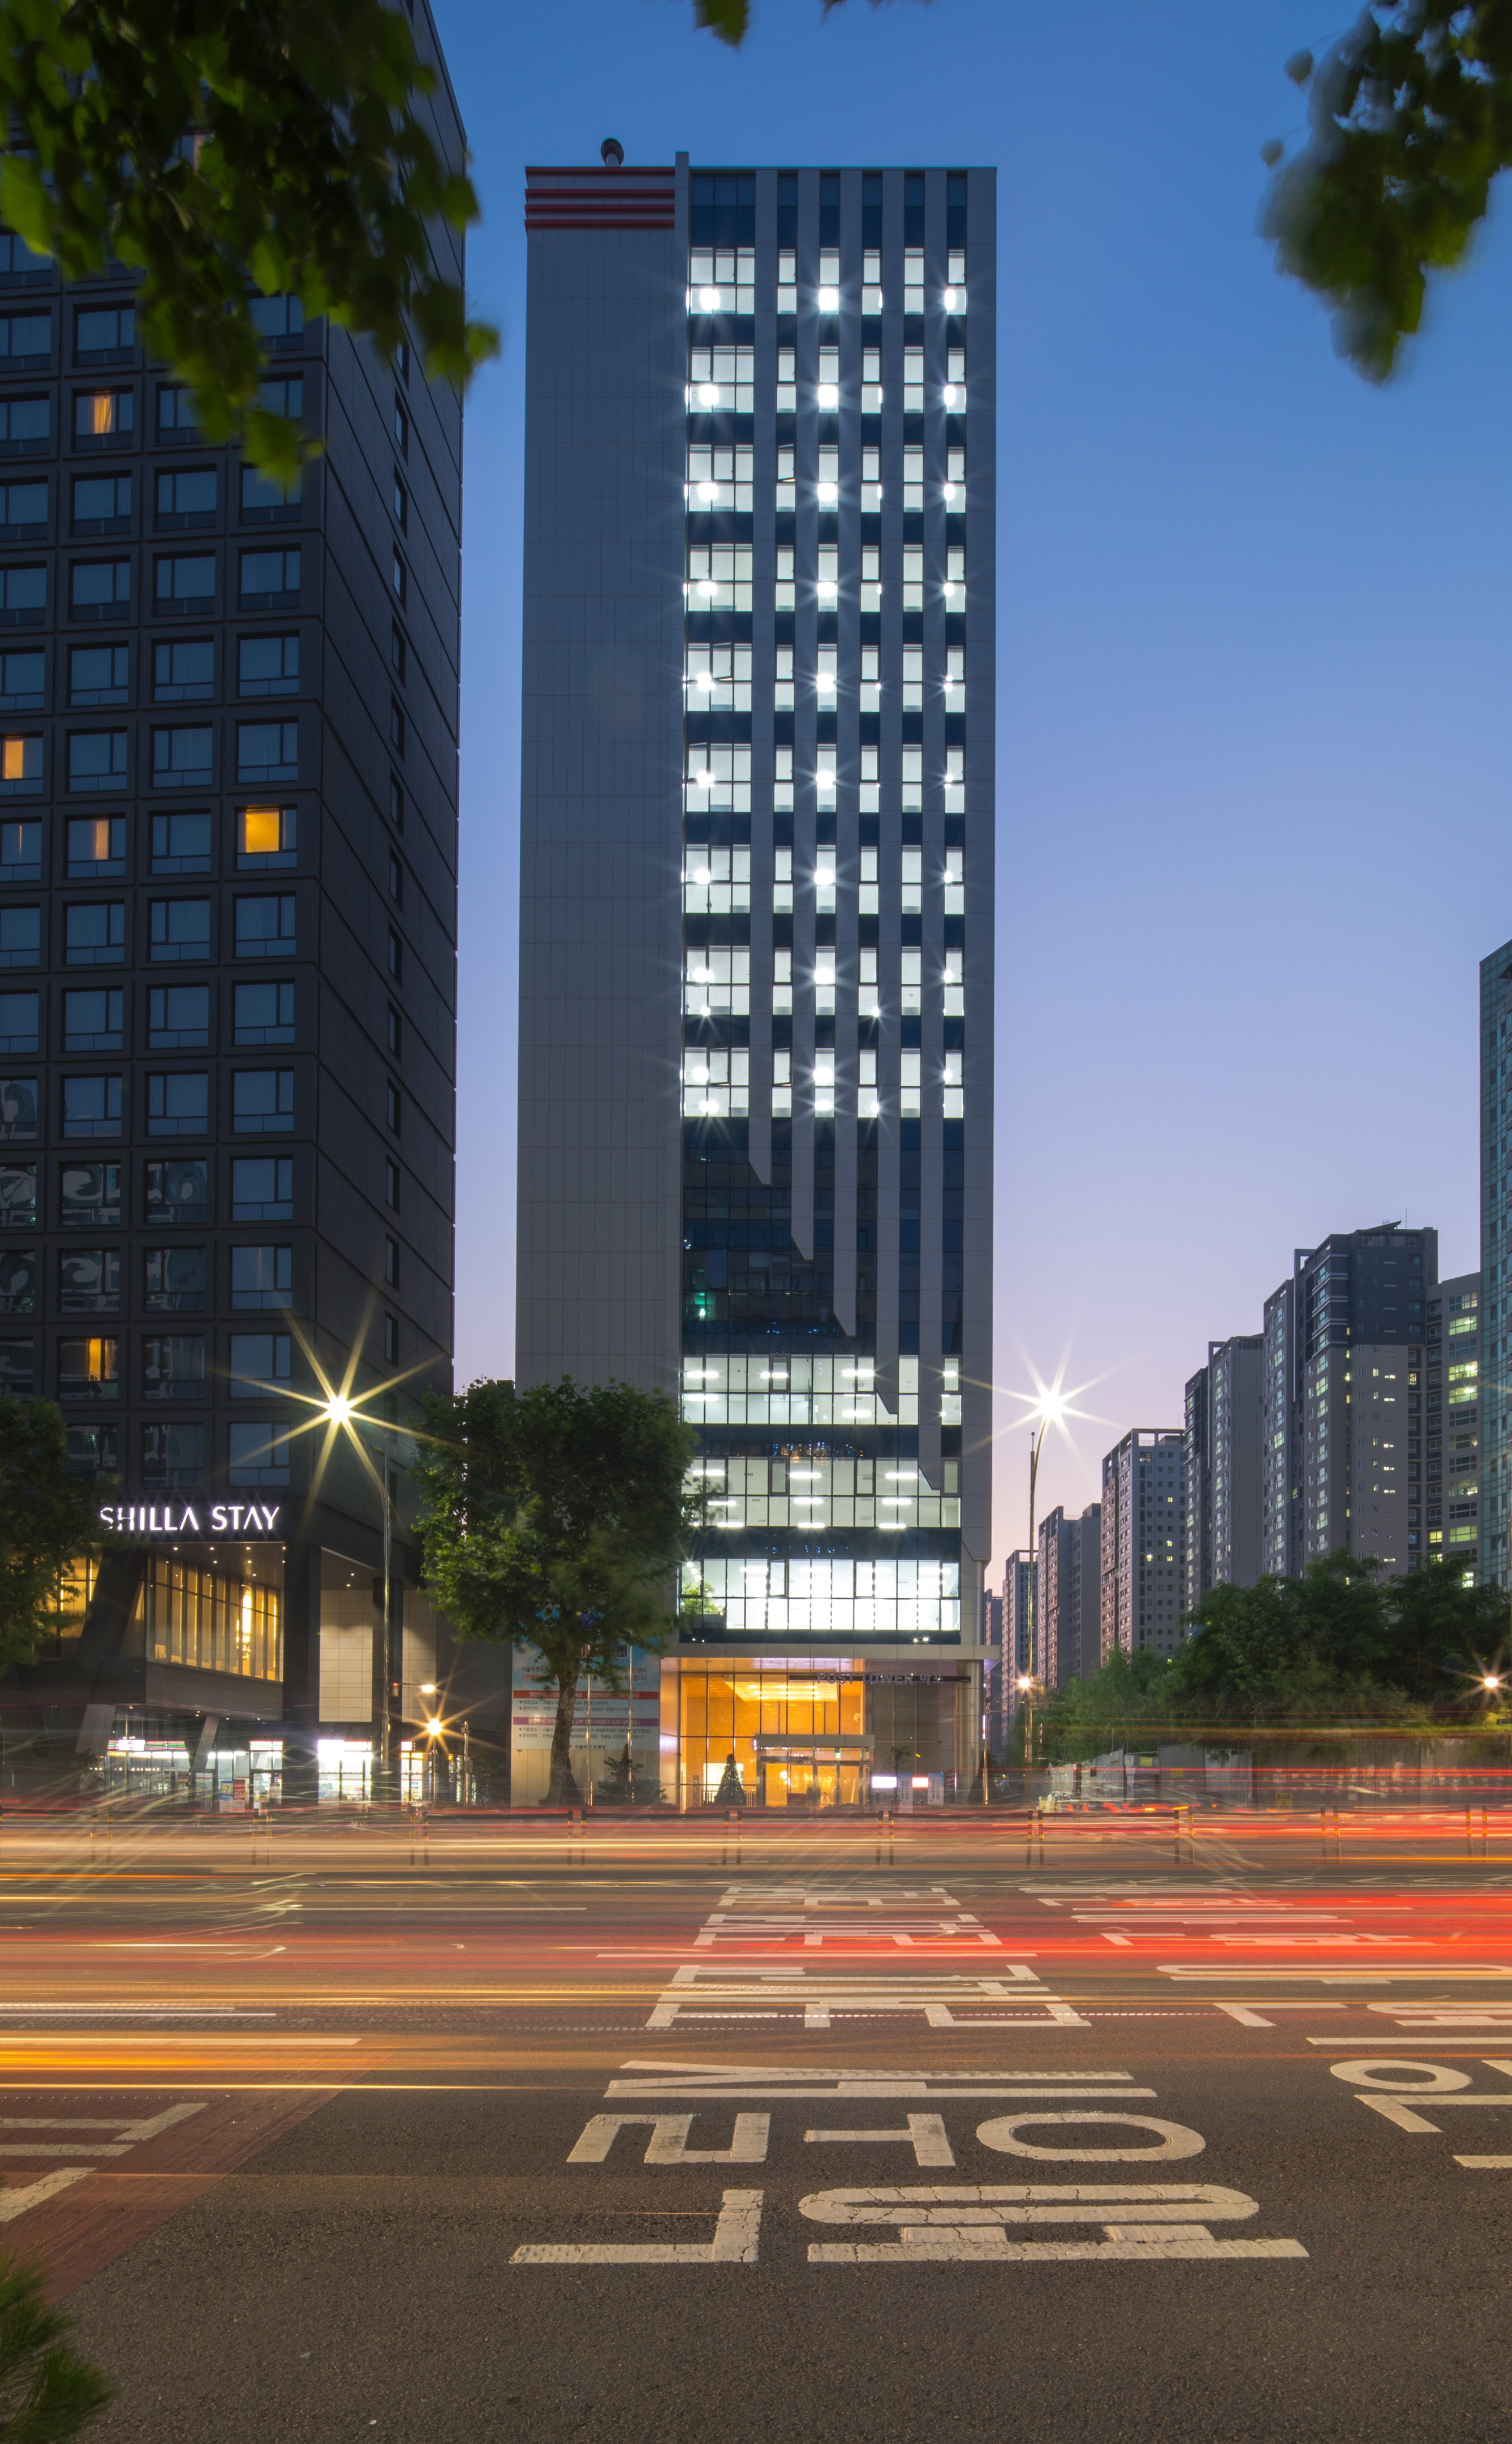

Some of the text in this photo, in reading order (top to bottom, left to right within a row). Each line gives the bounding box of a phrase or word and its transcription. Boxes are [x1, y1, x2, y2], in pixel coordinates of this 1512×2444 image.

[100, 1505, 279, 1532] SHILLA STAY
[817, 1672, 853, 1684] POST
[858, 1672, 914, 1685] TOWER
[645, 1965, 1092, 2028] 교차로
[509, 2060, 1309, 2265] 서울역
